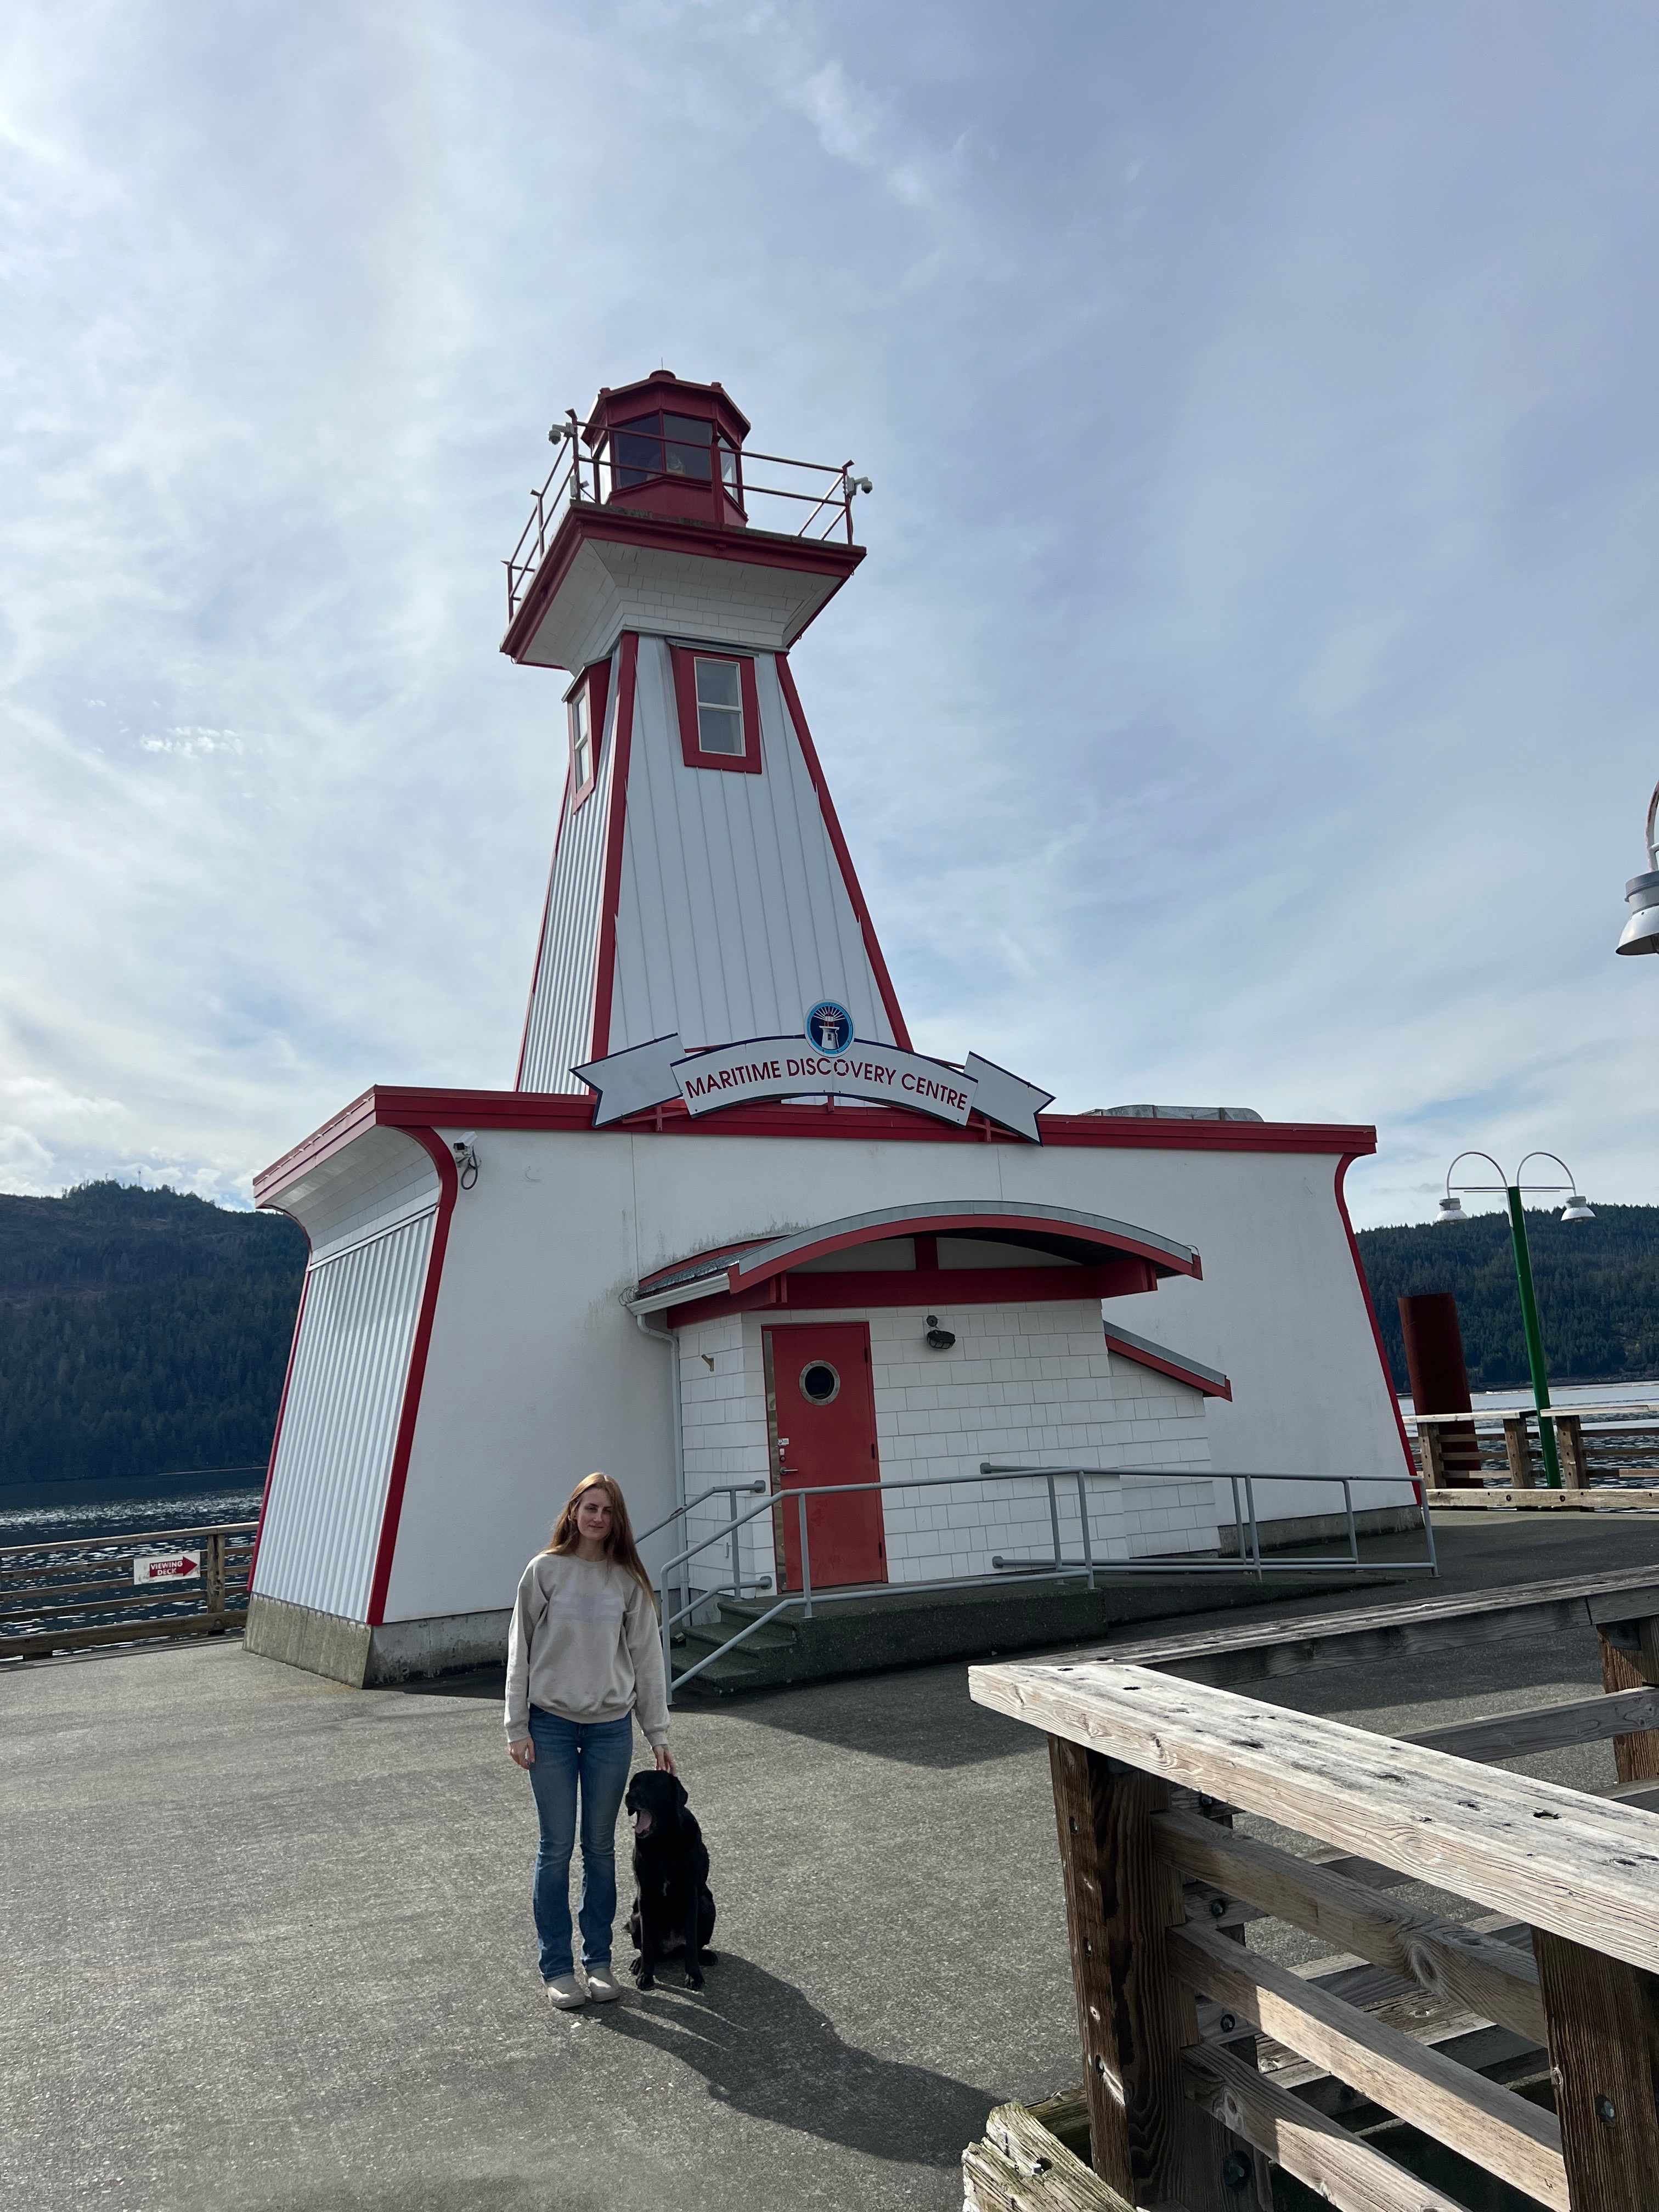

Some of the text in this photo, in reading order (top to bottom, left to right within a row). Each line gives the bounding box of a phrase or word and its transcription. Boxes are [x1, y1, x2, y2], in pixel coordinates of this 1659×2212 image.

[685, 1058, 968, 1110] MARITIME DISCOVERY CENTRE
[150, 1561, 183, 1570] VIEWING
